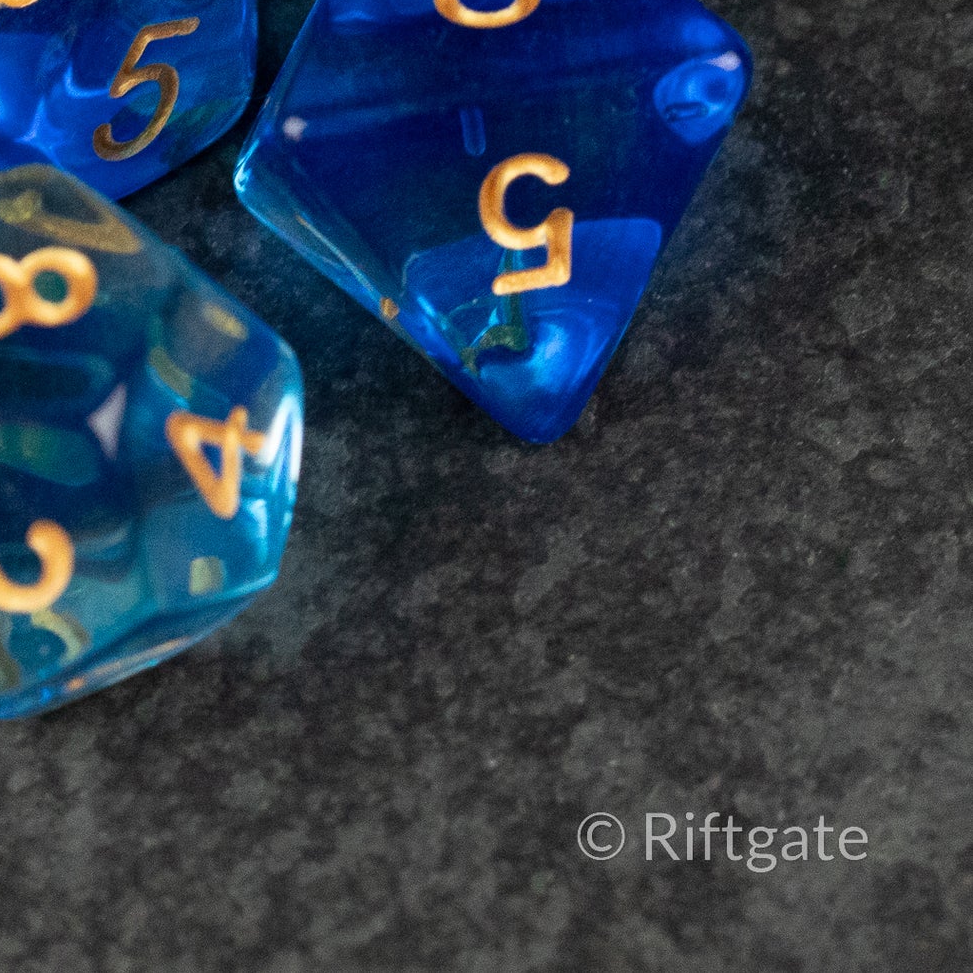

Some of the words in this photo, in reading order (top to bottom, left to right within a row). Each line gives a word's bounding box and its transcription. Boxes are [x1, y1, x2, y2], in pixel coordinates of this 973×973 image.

[92, 16, 201, 163] 5
[478, 152, 576, 297] 5
[163, 404, 267, 520] 4
